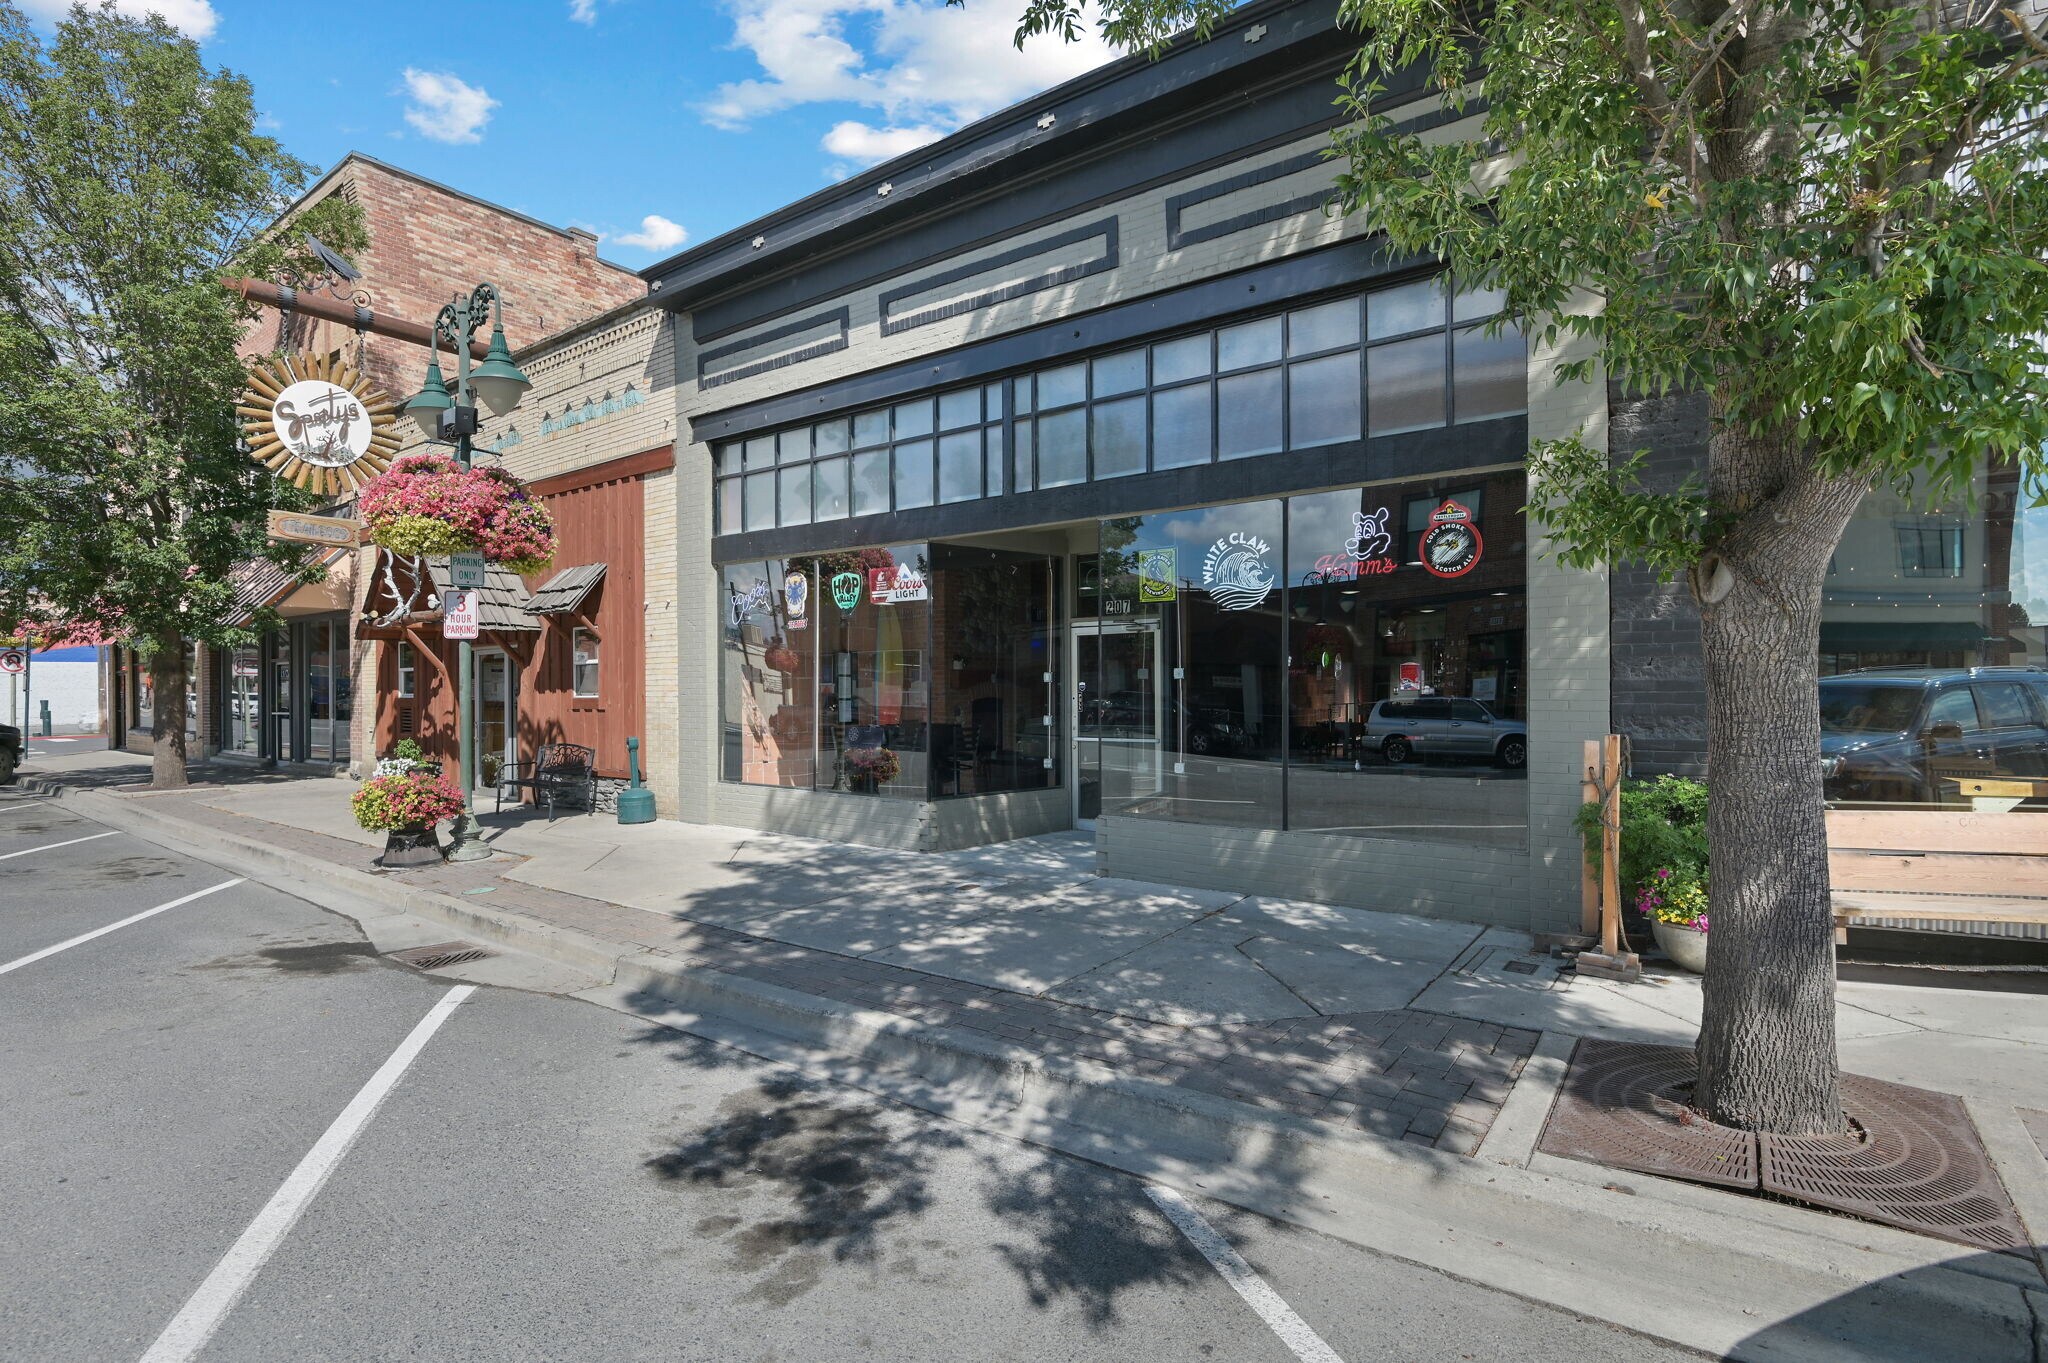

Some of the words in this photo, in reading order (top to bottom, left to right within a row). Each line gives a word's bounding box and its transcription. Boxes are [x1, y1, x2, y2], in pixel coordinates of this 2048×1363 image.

[1426, 528, 1440, 544] COLD
[1440, 523, 1466, 531] SMOKE
[452, 556, 483, 567] PARKING
[1202, 537, 1228, 585] WHITE
[1228, 531, 1271, 555] CLAW
[1434, 564, 1462, 573] SCOTCH
[1463, 554, 1474, 567] ALE
[1314, 553, 1398, 579] Hamm's
[458, 570, 477, 580] ONLY
[892, 574, 923, 590] Coors
[836, 593, 857, 603] VALLEY
[895, 589, 919, 599] LIGHT
[455, 595, 467, 612] 3
[1105, 600, 1131, 615] 207
[450, 614, 472, 623] HOUR
[446, 625, 476, 635] PARKING
